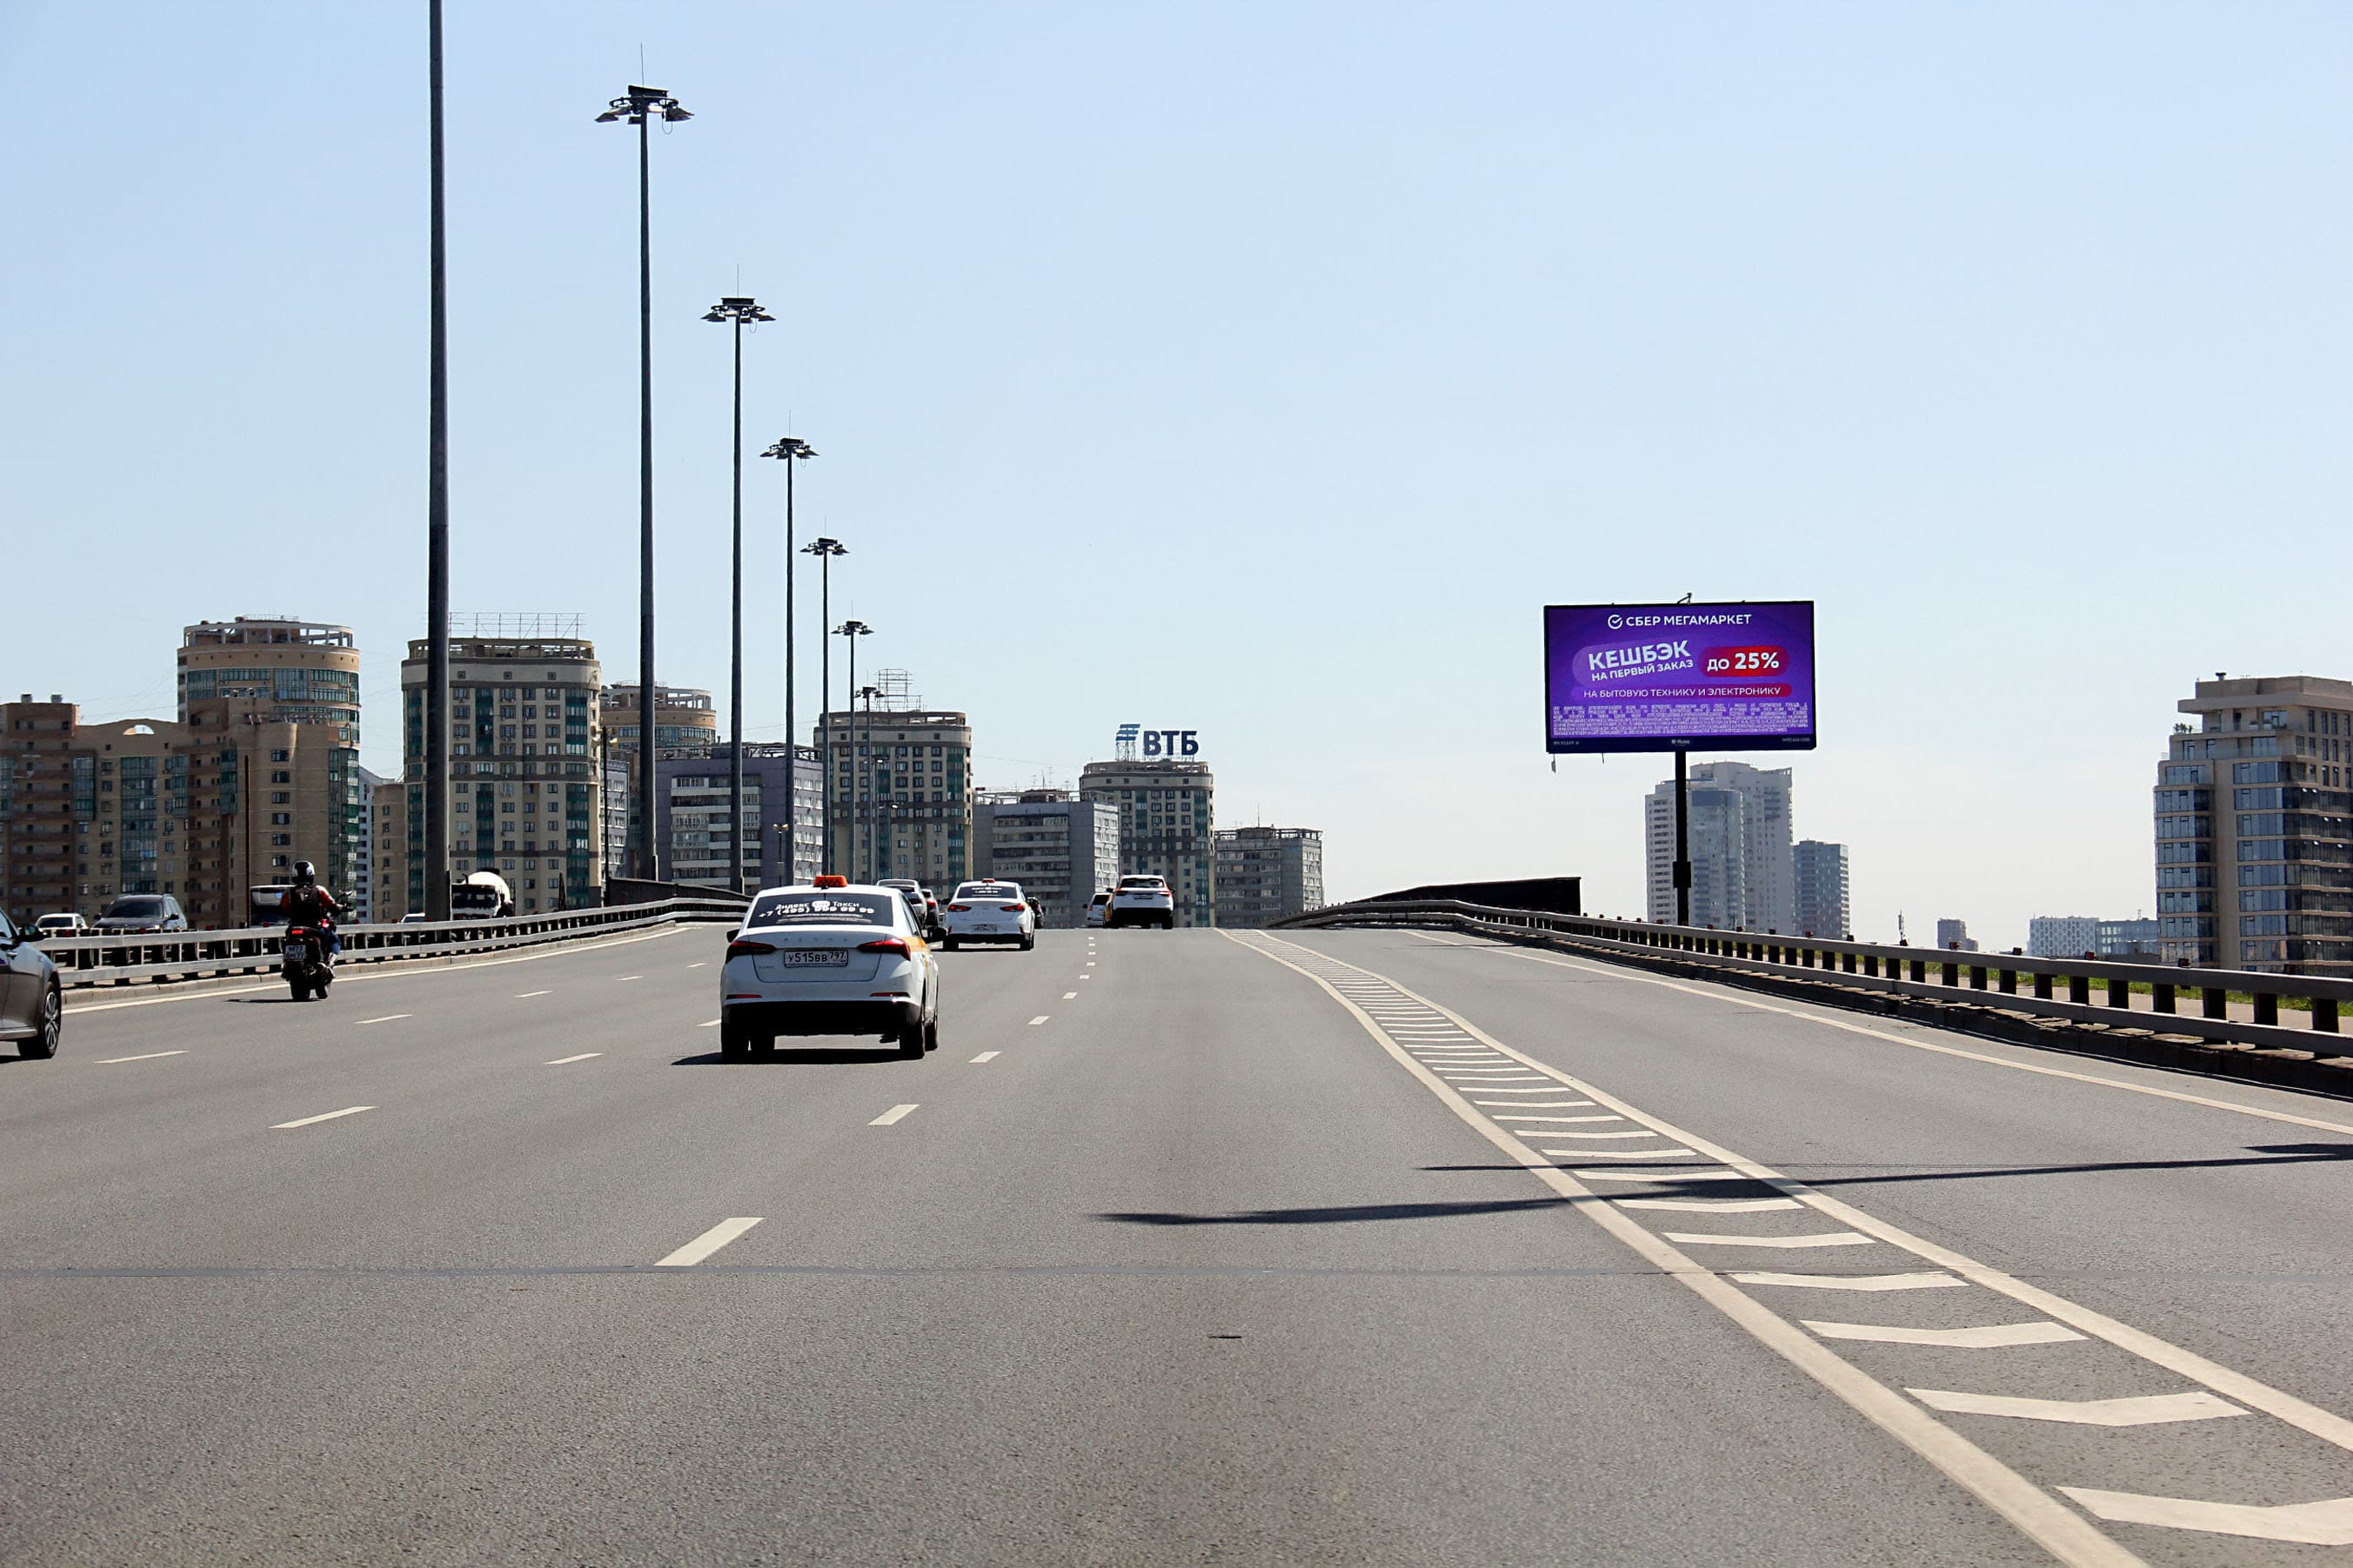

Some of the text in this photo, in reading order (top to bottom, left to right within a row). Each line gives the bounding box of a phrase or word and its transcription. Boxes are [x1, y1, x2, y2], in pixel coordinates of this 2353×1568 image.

[1626, 614, 1752, 626] СБЕР МЕГАМАРКЕТ
[1588, 640, 1691, 671] КЕШБЭК
[1735, 651, 1780, 670] 25%
[1591, 659, 1694, 682] НА ПЕРВЫЙ ЗАКАЗ
[1600, 689, 1648, 697] БЫТОВУЮ
[1650, 688, 1695, 697] ТЕХНИКУ
[1708, 687, 1781, 696] ЭЛЕКТРОНИКУ
[1143, 730, 1199, 756] ВТБ
